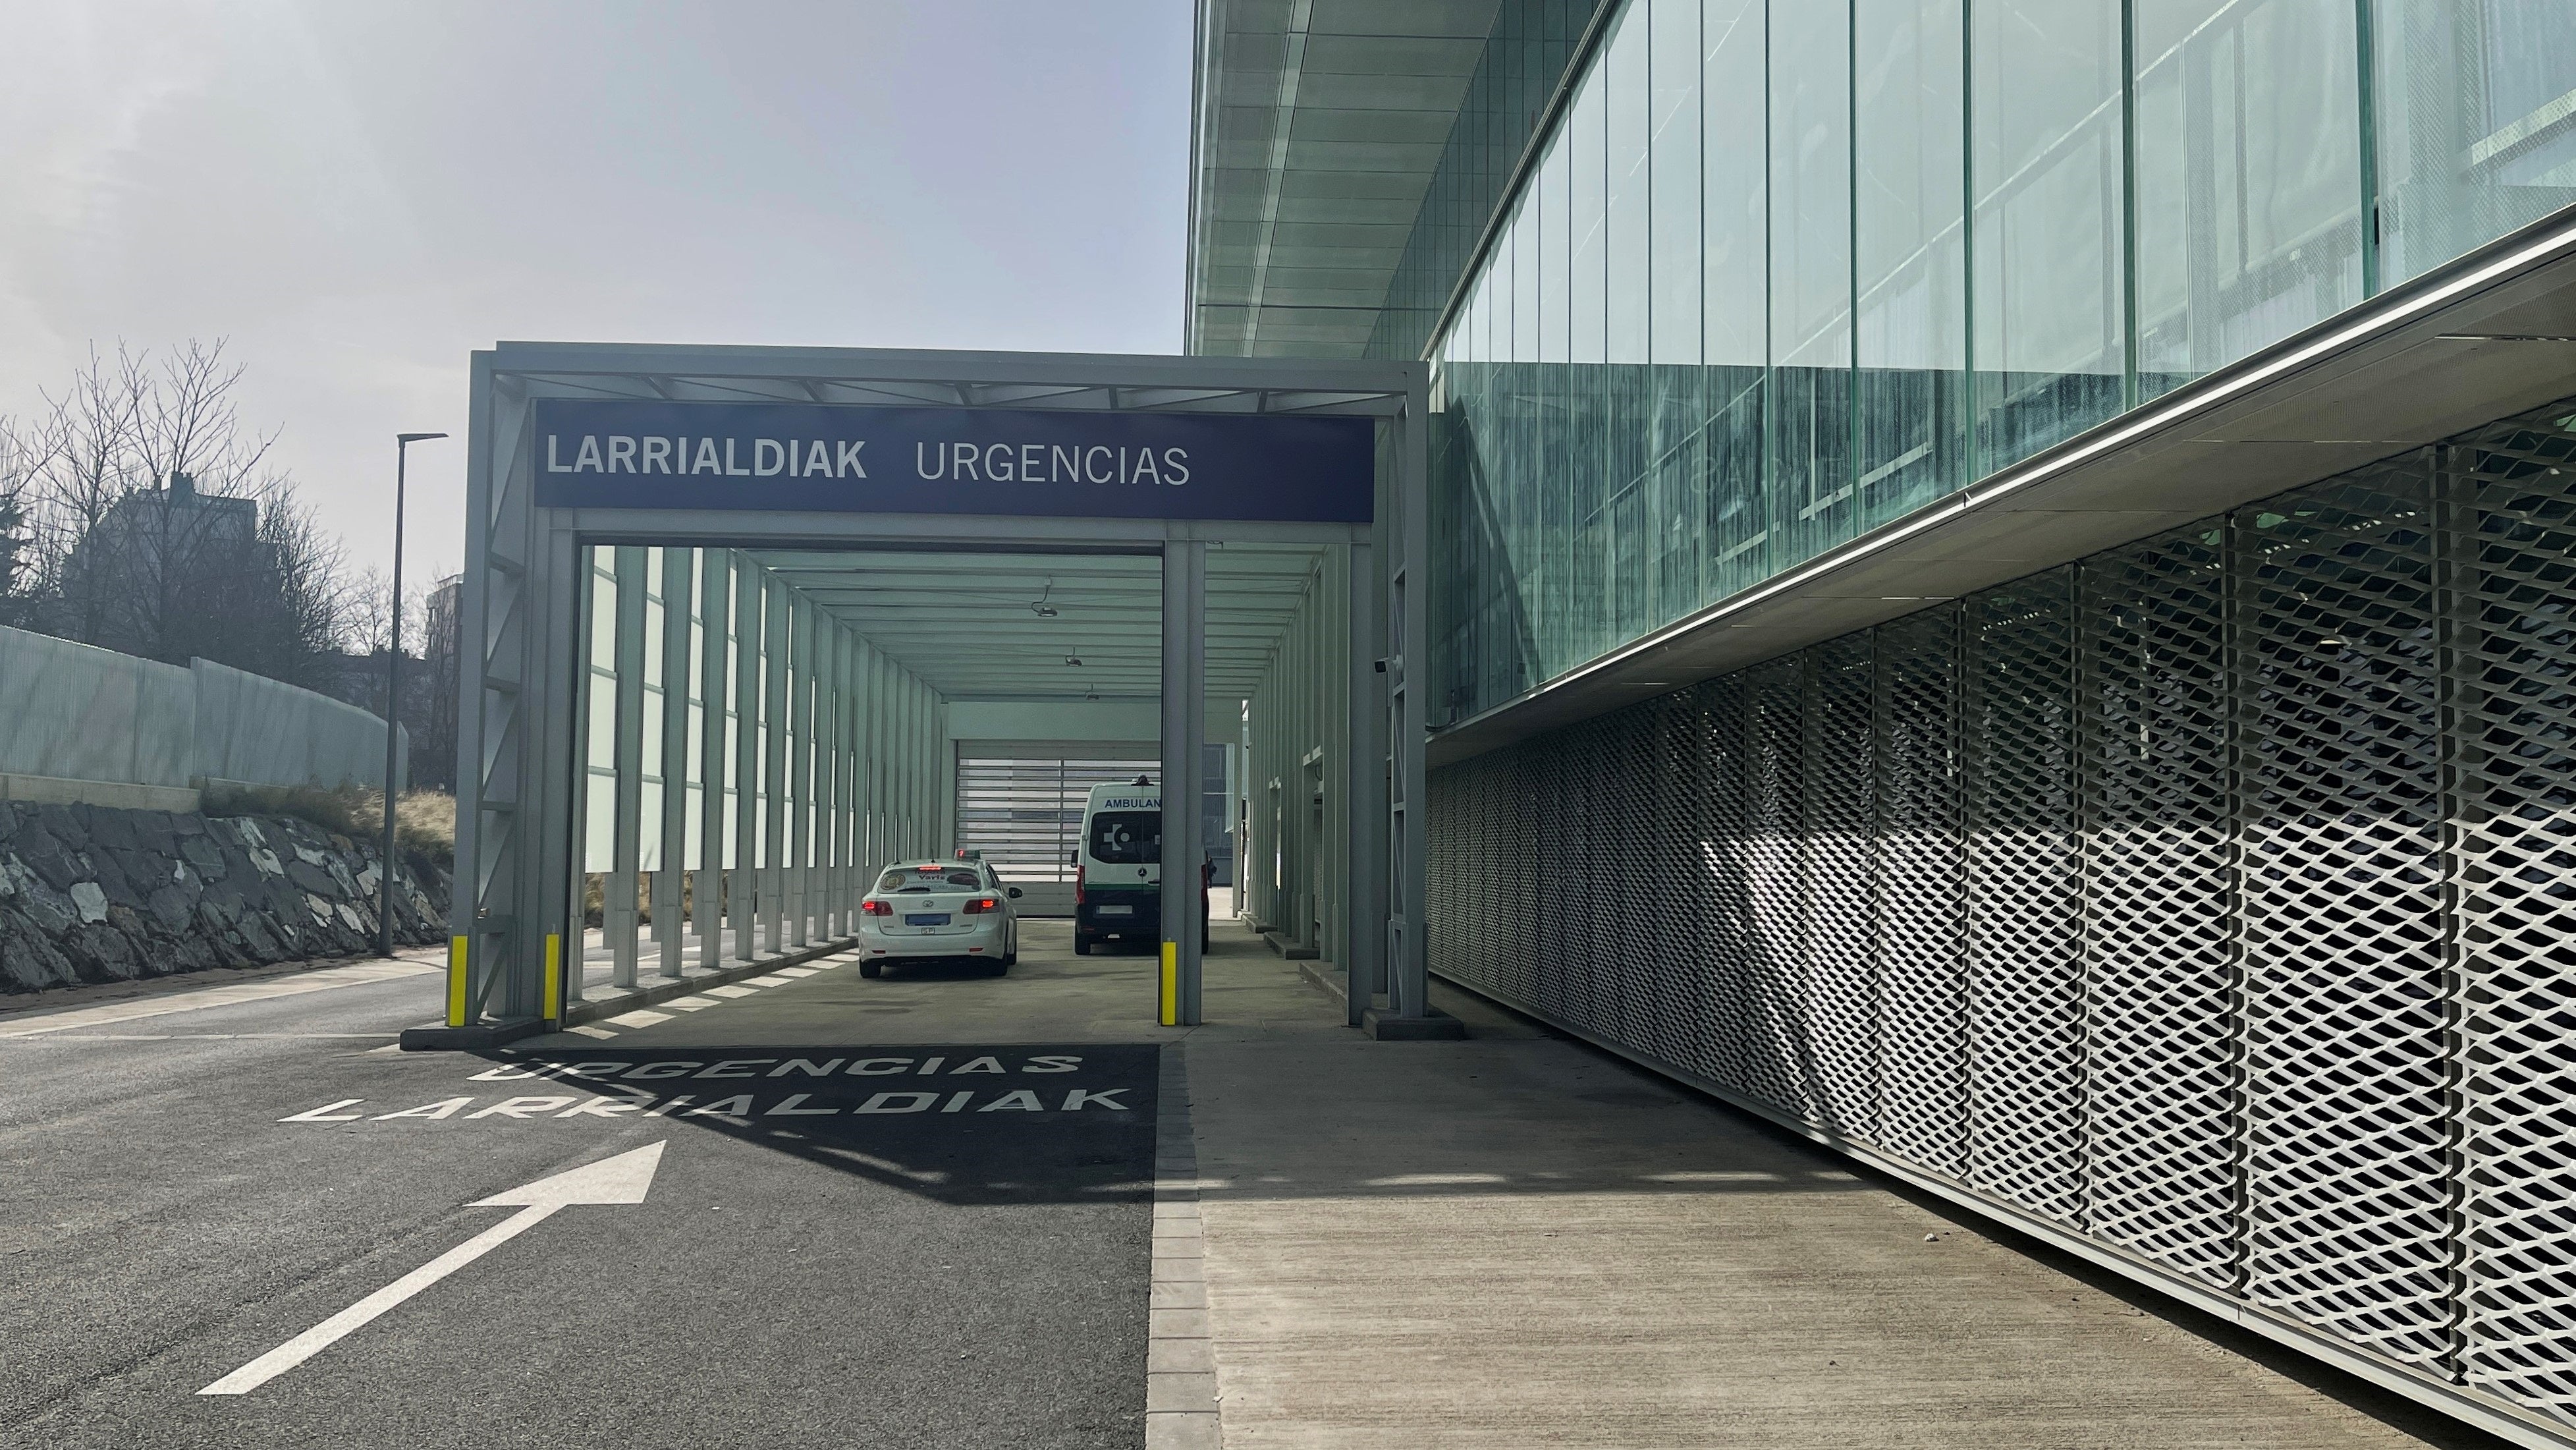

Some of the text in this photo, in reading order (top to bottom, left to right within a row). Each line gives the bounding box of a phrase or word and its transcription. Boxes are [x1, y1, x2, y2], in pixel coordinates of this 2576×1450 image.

[547, 435, 1190, 486] LARRIALDIAK URGENCIAS
[1105, 799, 1161, 808] AMBULAN
[466, 1055, 1083, 1081] URGENCIAS
[276, 1088, 1131, 1123] LARRIALDIAK
